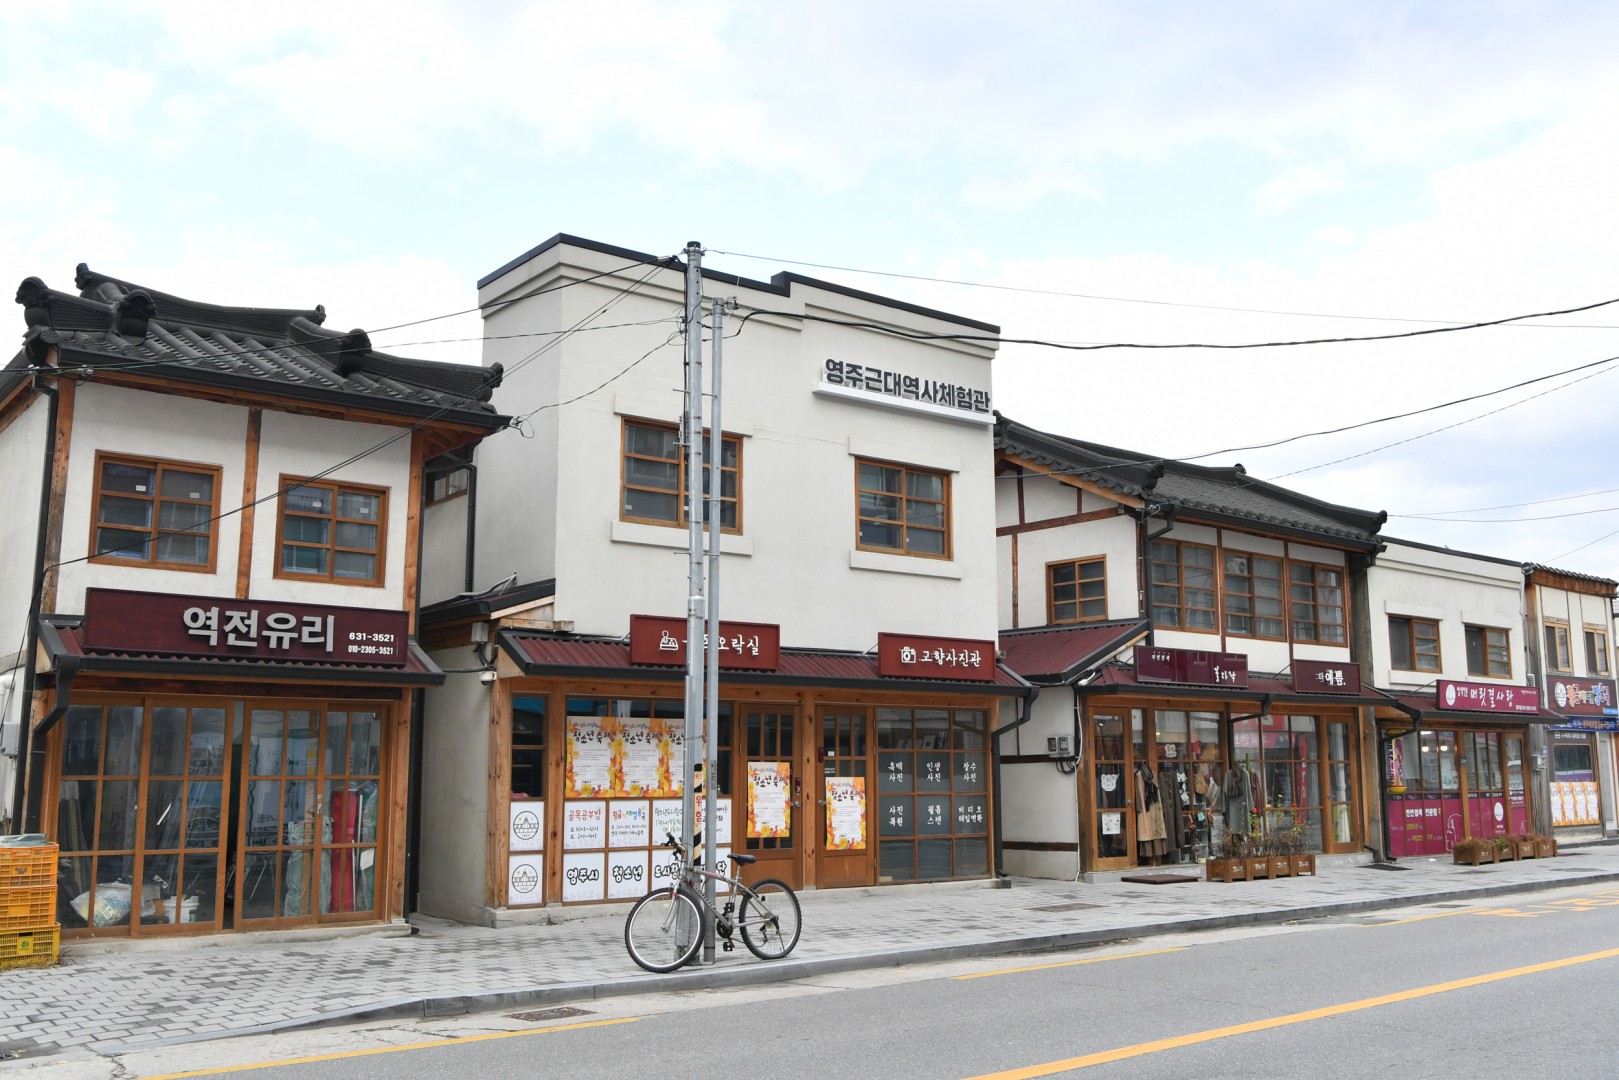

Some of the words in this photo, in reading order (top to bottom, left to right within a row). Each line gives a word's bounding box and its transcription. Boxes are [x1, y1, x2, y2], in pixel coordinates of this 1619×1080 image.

[825, 358, 990, 413] 영주근대역사체험관
[184, 606, 334, 652] 역전유리
[349, 632, 394, 644] 631-3521
[348, 645, 393, 656] 010-2305-3521
[921, 648, 981, 668] 고향사진관
[573, 730, 595, 744] 청소년
[596, 731, 611, 744] 축제
[622, 730, 643, 744] 청소년
[645, 732, 659, 745] 축제
[669, 732, 684, 745] 청소
[926, 762, 941, 772] 인생
[963, 763, 977, 772] 장수
[889, 773, 903, 783] 사진
[926, 773, 941, 782] 사진
[963, 773, 977, 782] 사진
[569, 809, 602, 822] 골목공부방
[889, 806, 904, 816] 사진
[889, 817, 903, 827] 복원
[927, 815, 942, 825] 스캔
[567, 867, 600, 885] 영주시
[613, 865, 643, 883] 청소년
